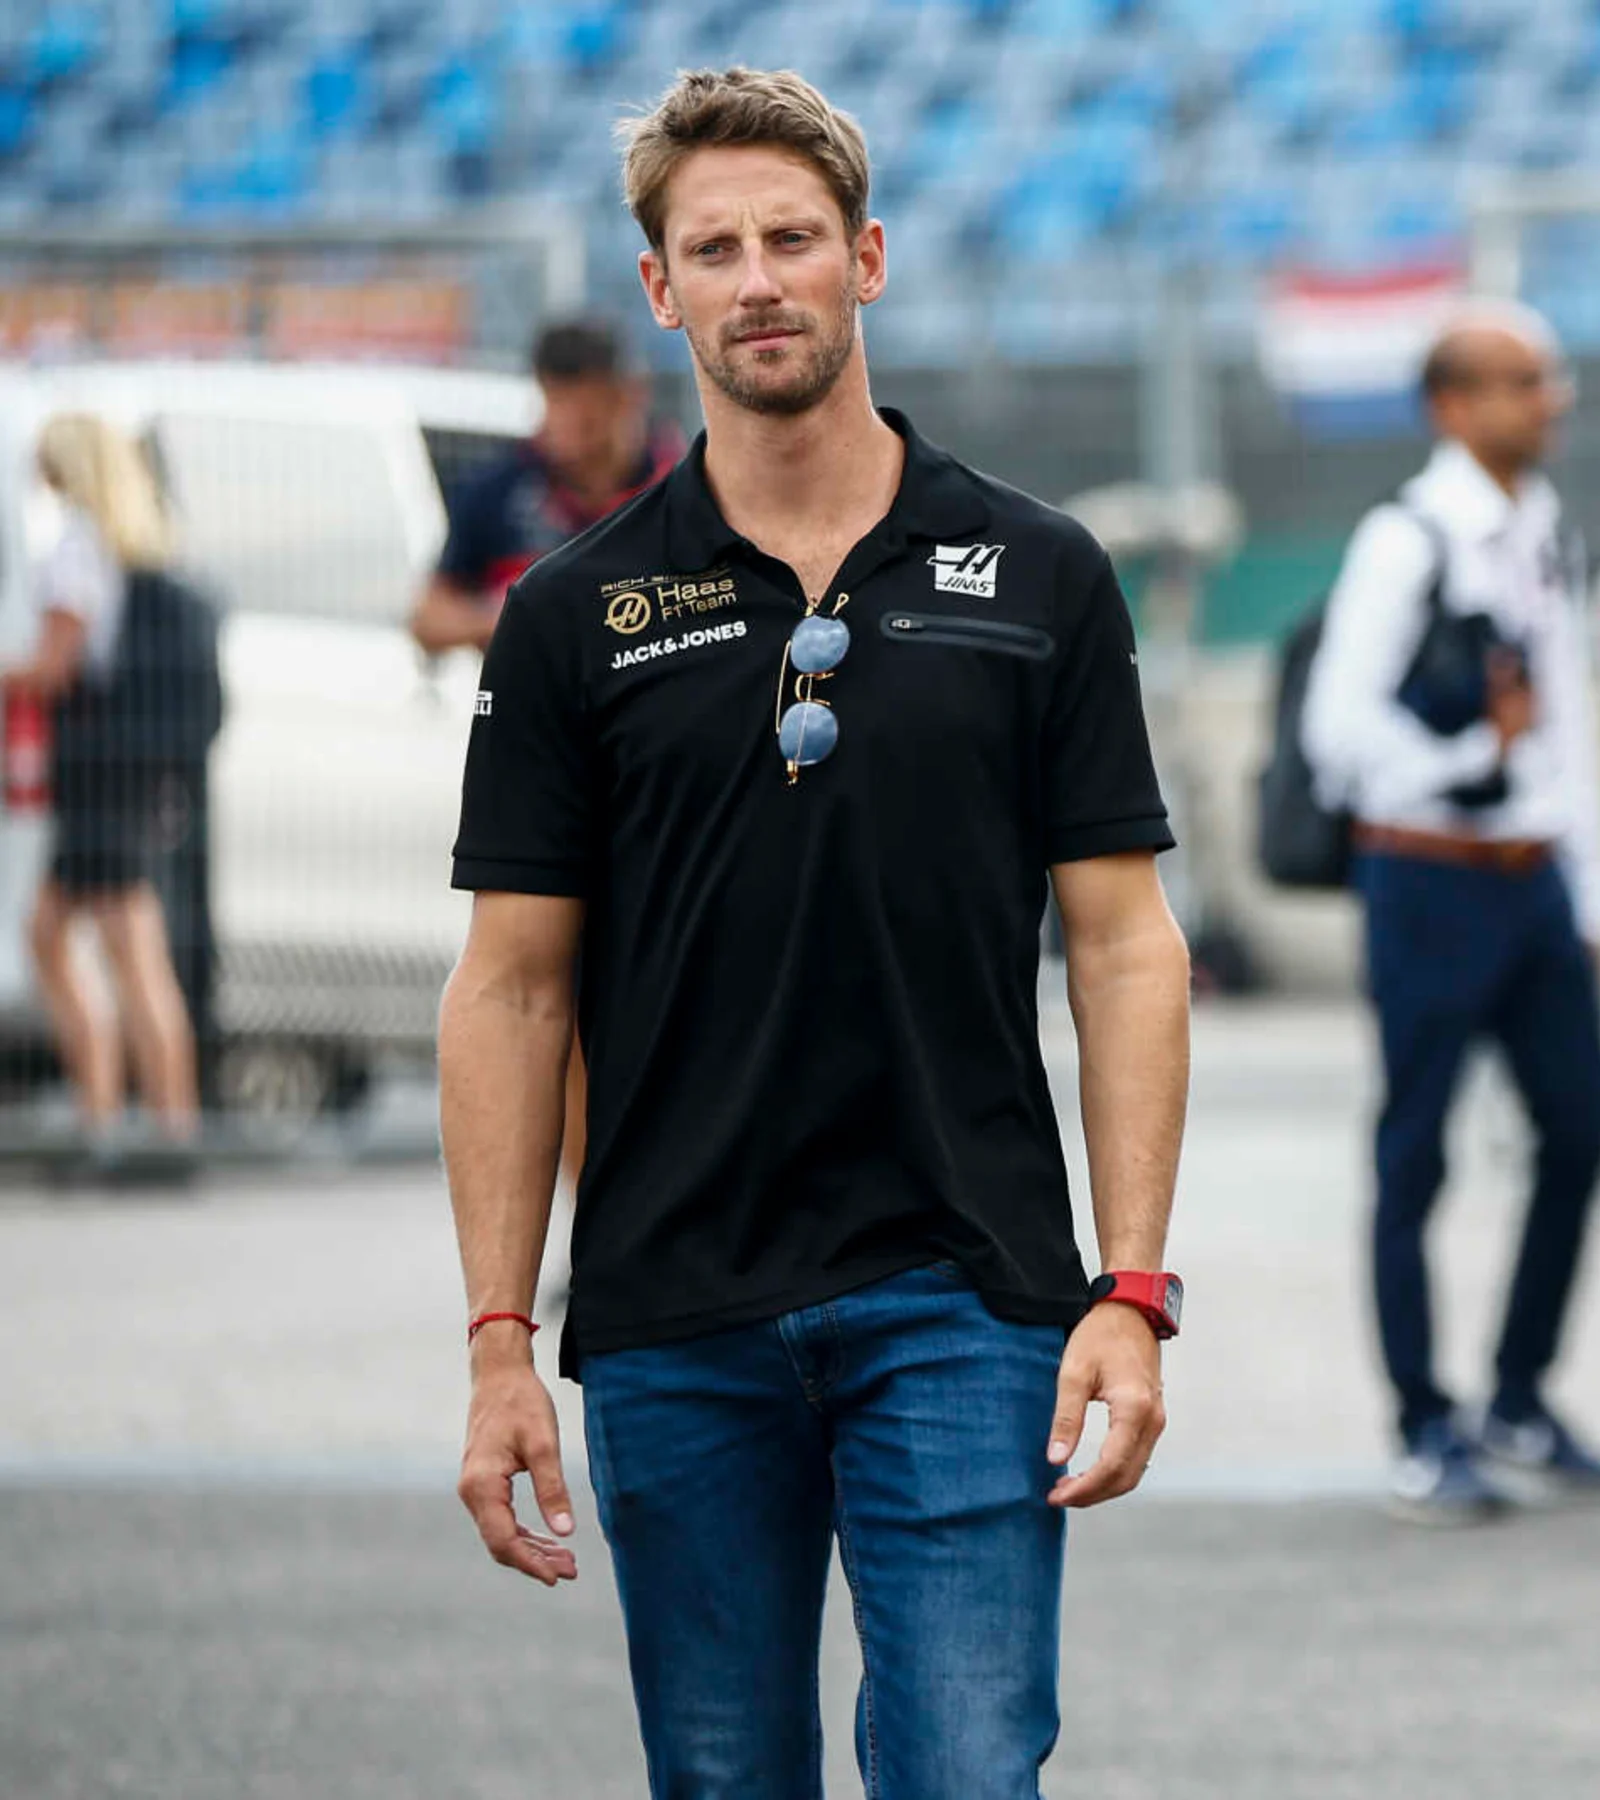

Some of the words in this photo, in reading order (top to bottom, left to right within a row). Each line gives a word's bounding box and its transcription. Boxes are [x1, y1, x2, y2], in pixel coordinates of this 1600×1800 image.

[600, 576, 645, 593] RICH
[657, 578, 735, 607] Haas
[661, 605, 682, 622] F1
[685, 592, 738, 615] Team
[611, 620, 747, 669] JACK&JONES
